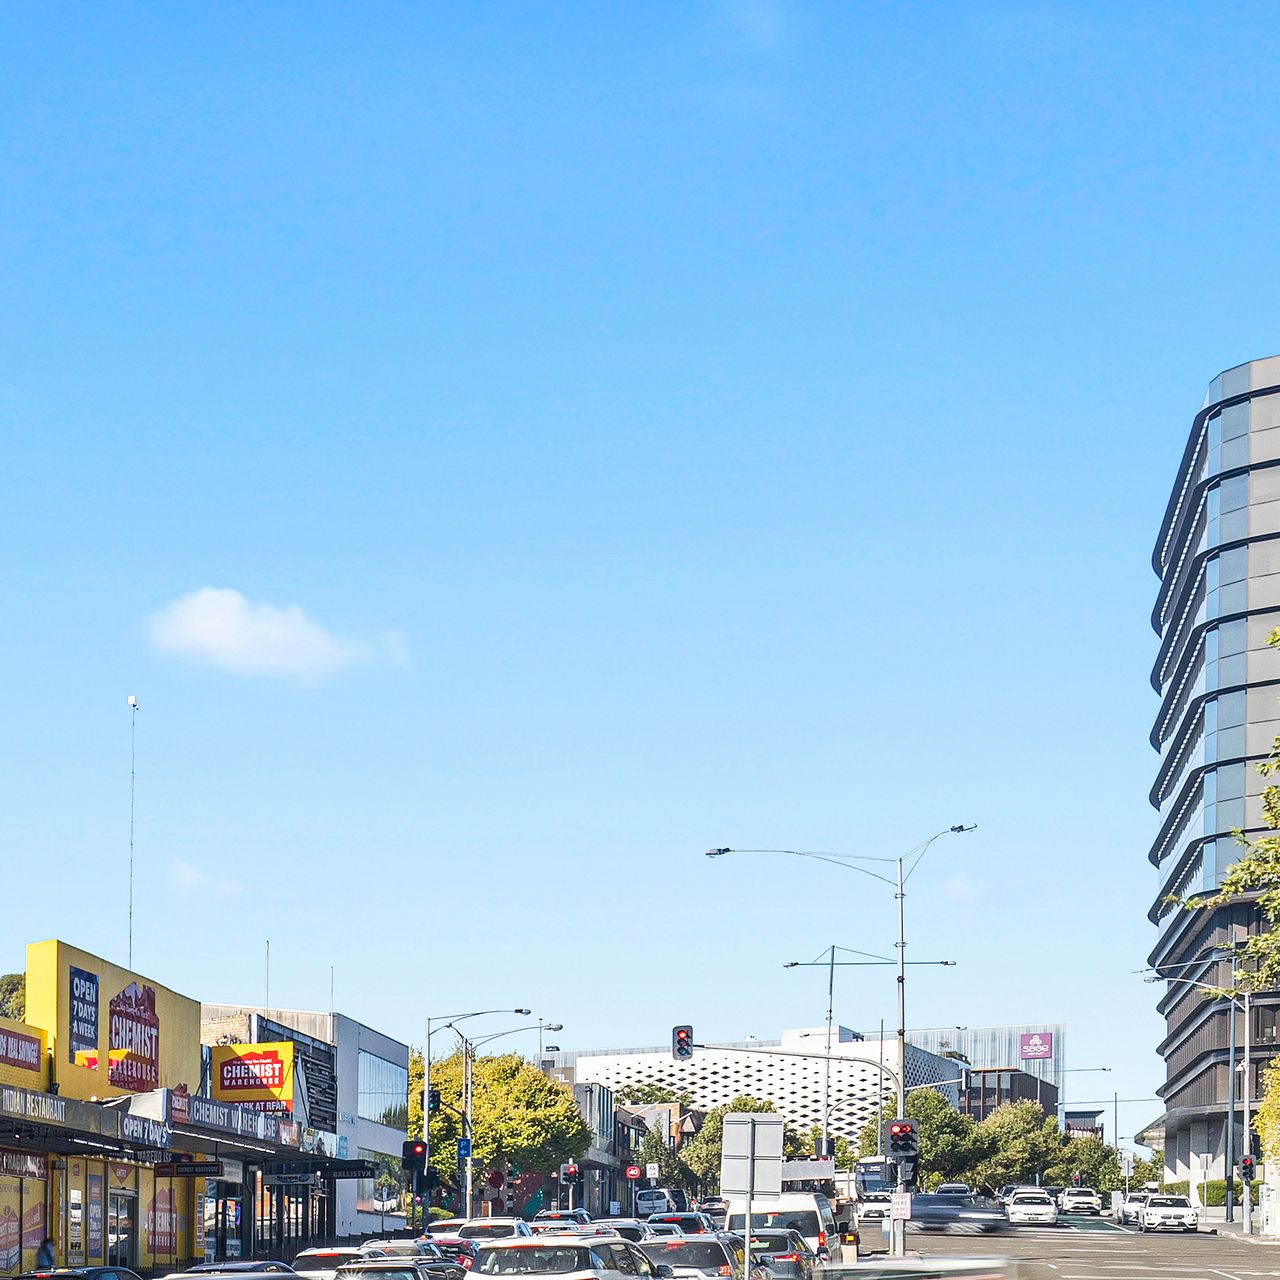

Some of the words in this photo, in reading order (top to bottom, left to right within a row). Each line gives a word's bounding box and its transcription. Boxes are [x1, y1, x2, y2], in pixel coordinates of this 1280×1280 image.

[73, 977, 96, 1003] OPEN
[73, 1000, 78, 1015] 7
[78, 1002, 96, 1021] DAYS
[73, 1020, 78, 1034] A
[79, 1021, 96, 1040] WEEK
[112, 1014, 158, 1060] CHEMIST
[223, 1063, 281, 1078] CHEMIST
[223, 1077, 280, 1086] WAREHOUSE
[2, 1088, 25, 1114] INDIAN
[26, 1093, 66, 1122] RESTAURANT
[193, 1100, 228, 1128] CHEMIST
[123, 1117, 142, 1138] OPEN
[144, 1121, 150, 1140] 7
